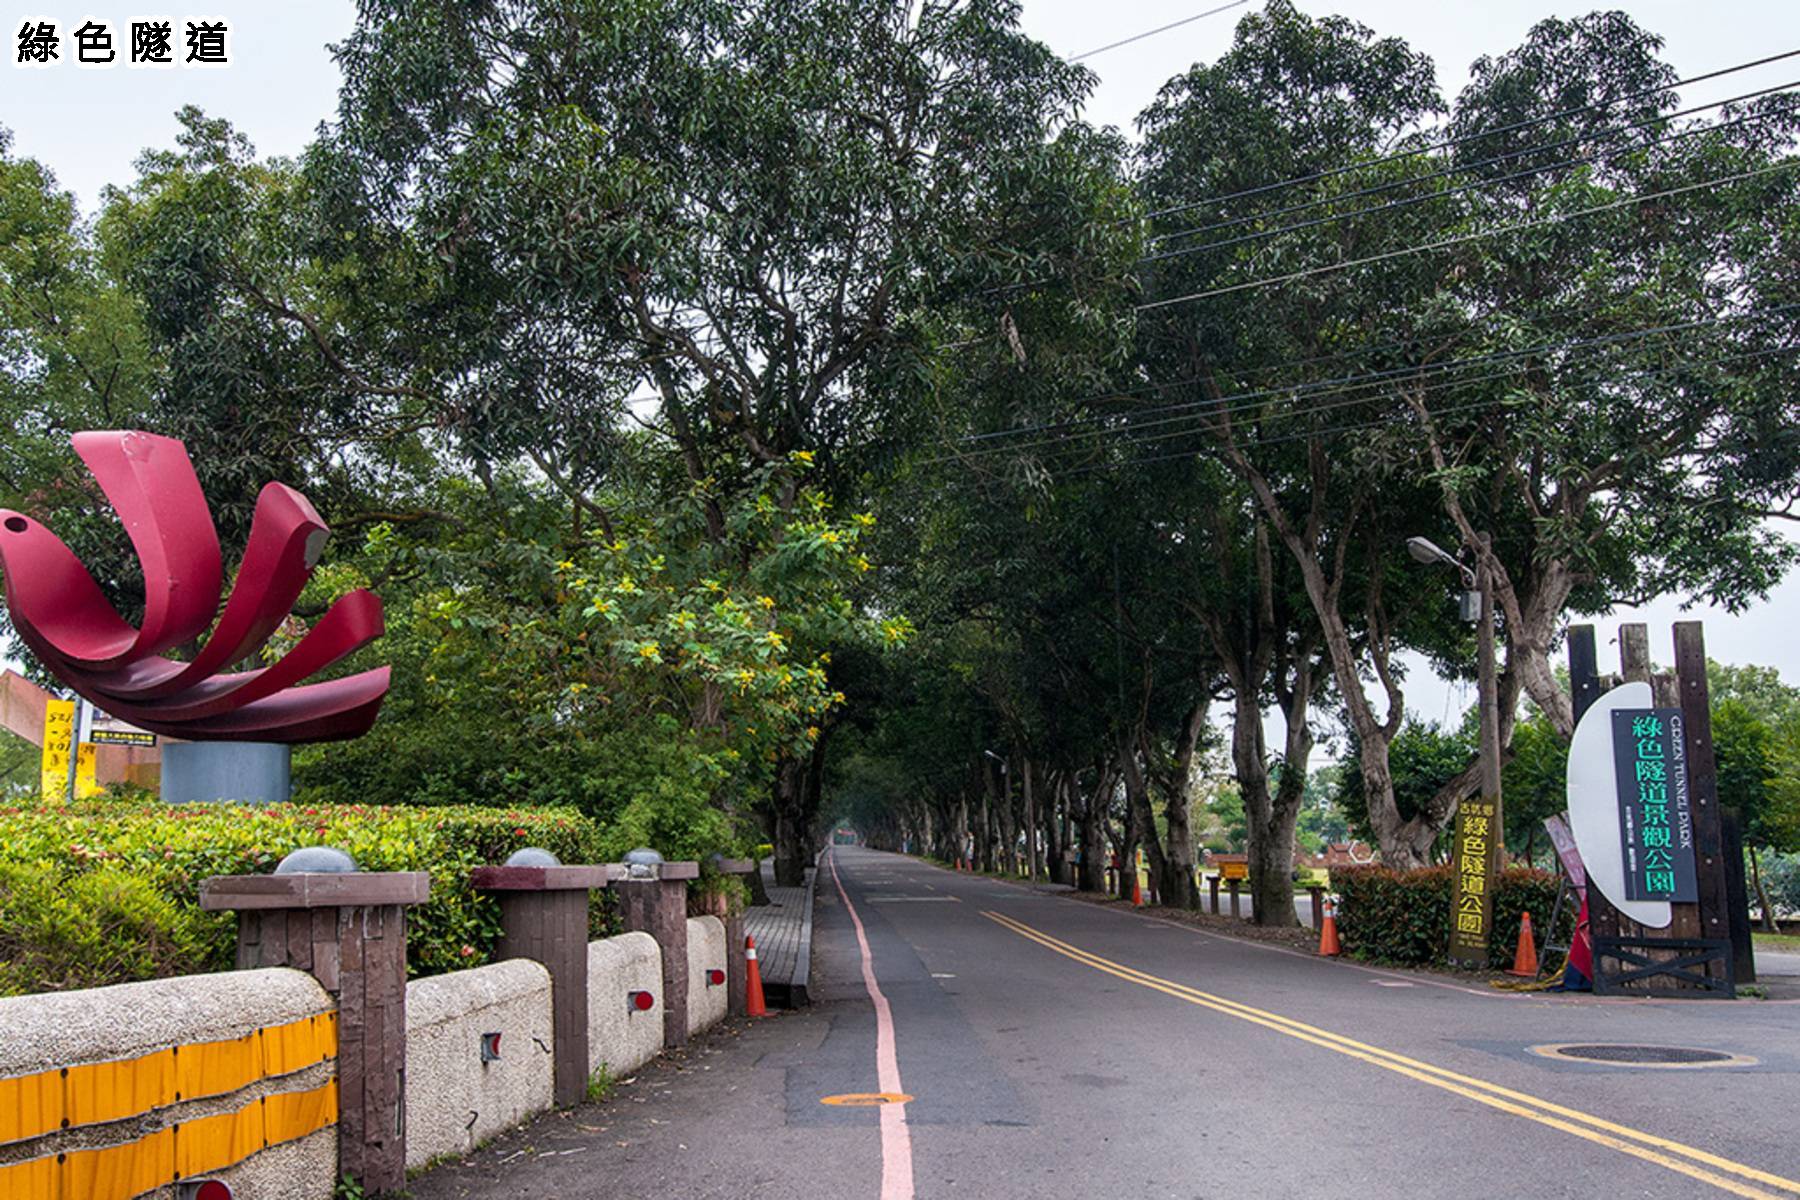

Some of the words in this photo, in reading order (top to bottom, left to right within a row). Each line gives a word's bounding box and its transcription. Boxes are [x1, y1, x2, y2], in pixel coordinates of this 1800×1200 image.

[1669, 715, 1683, 761] GREEN
[1632, 715, 1675, 894] 綠色隧道景觀公園
[1674, 763, 1687, 810] TUNNEL
[1678, 811, 1691, 849] PARK
[1457, 817, 1489, 934] 綠色隧道公園
